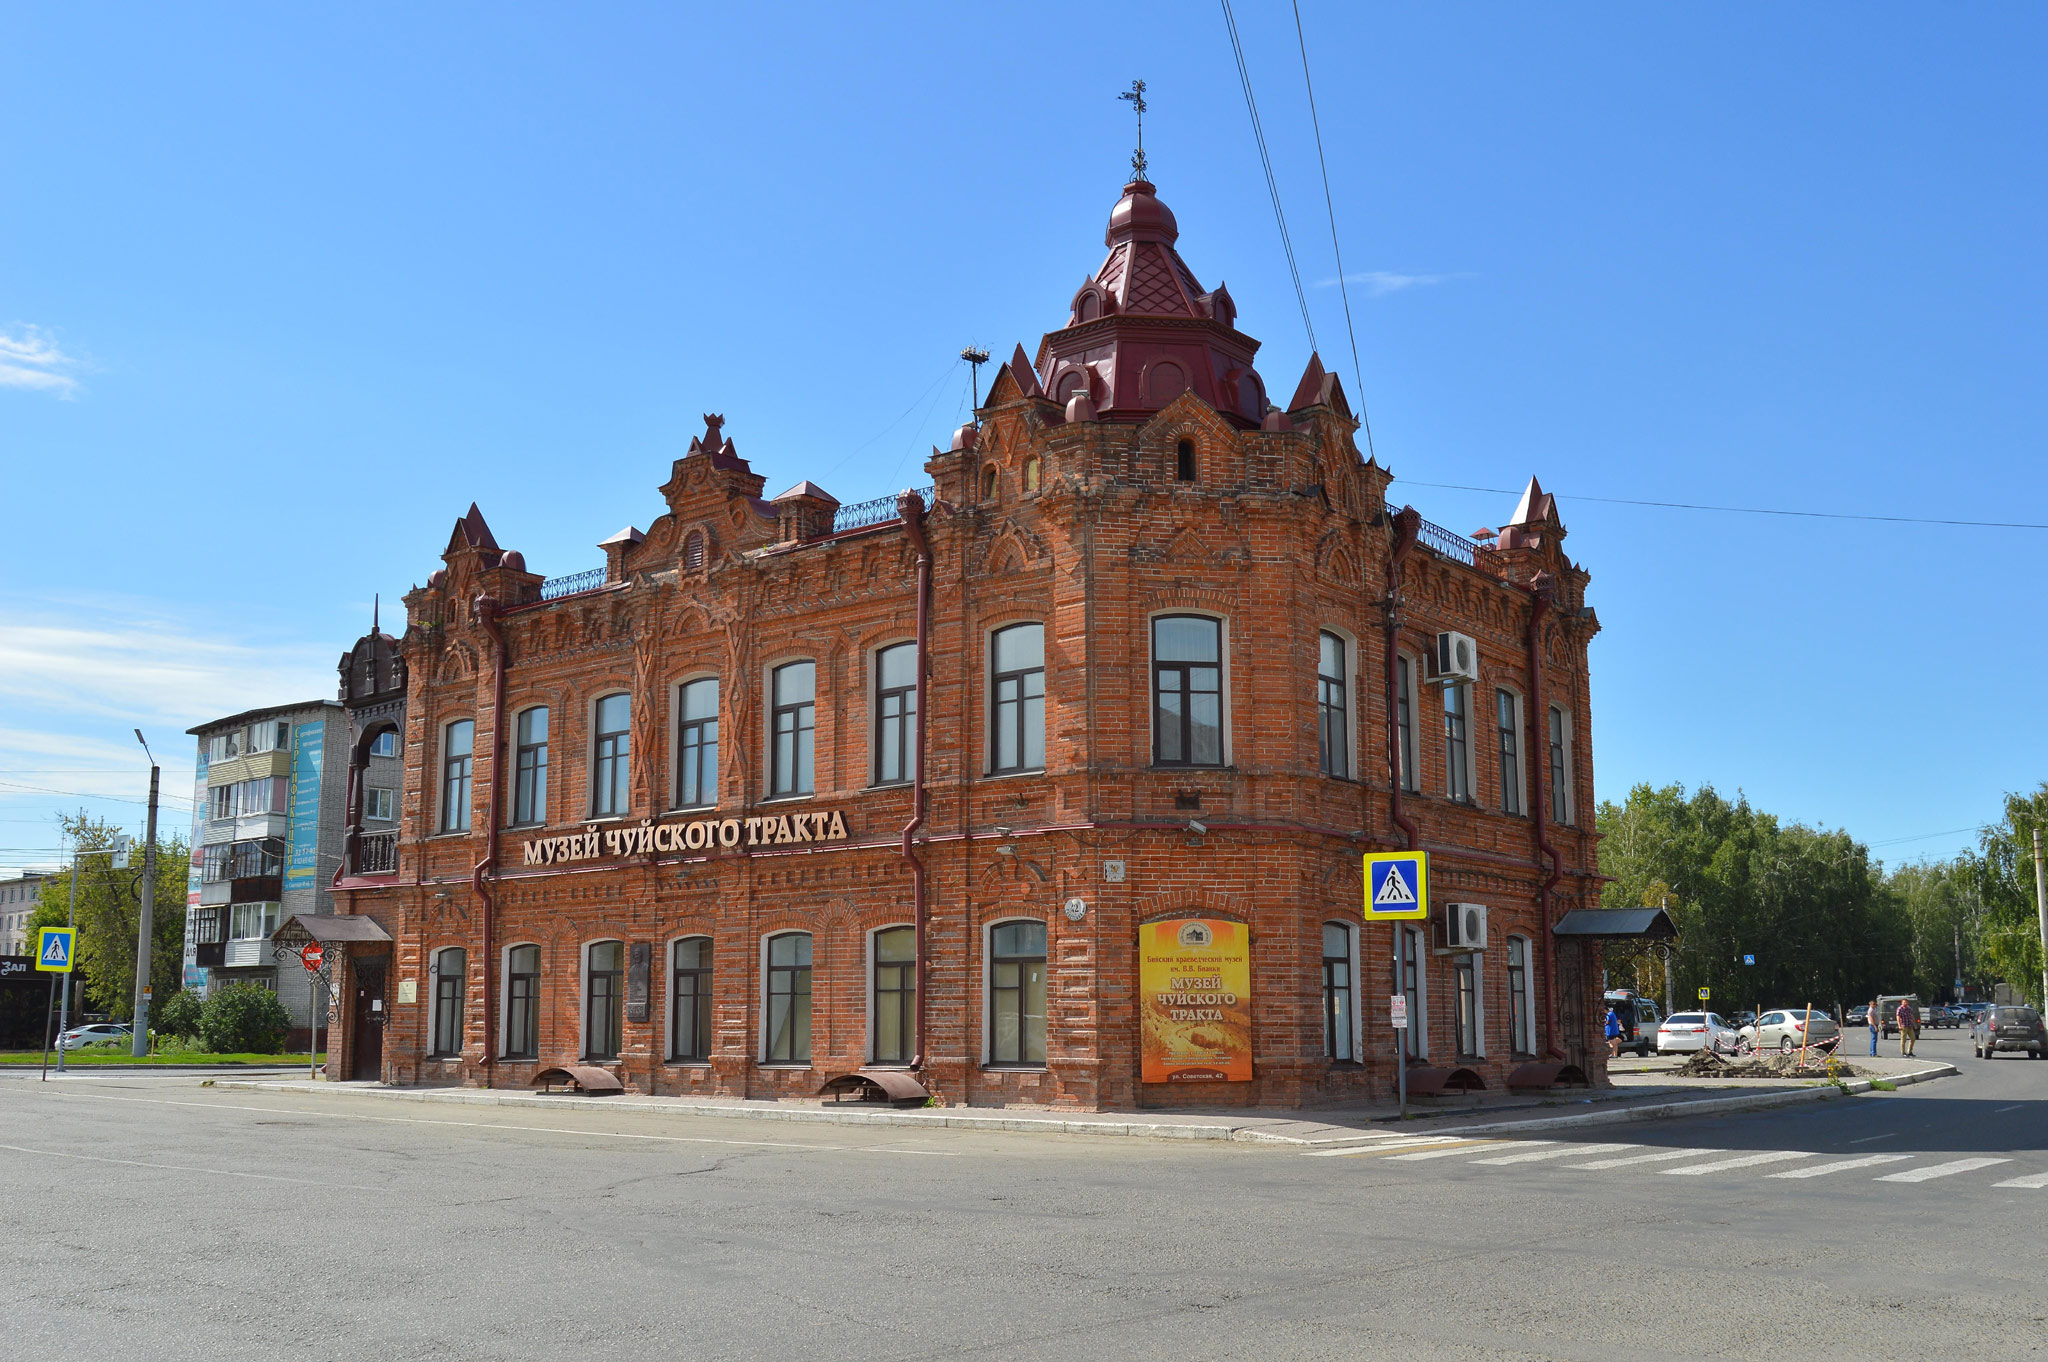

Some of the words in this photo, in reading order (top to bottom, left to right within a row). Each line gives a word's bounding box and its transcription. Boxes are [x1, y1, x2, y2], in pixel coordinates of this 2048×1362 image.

[523, 824, 601, 866] МУЗЕЙ
[604, 819, 741, 857] ЧУЙСКОГО
[744, 810, 849, 845] ТРАКТА
[1176, 956, 1222, 964] краеведческий
[1224, 956, 1243, 964] музей
[1170, 974, 1222, 990] МУЗЕЙ
[1157, 991, 1236, 1006] ЧУЙСКОГО
[1170, 1008, 1223, 1021] ТРАКТА
